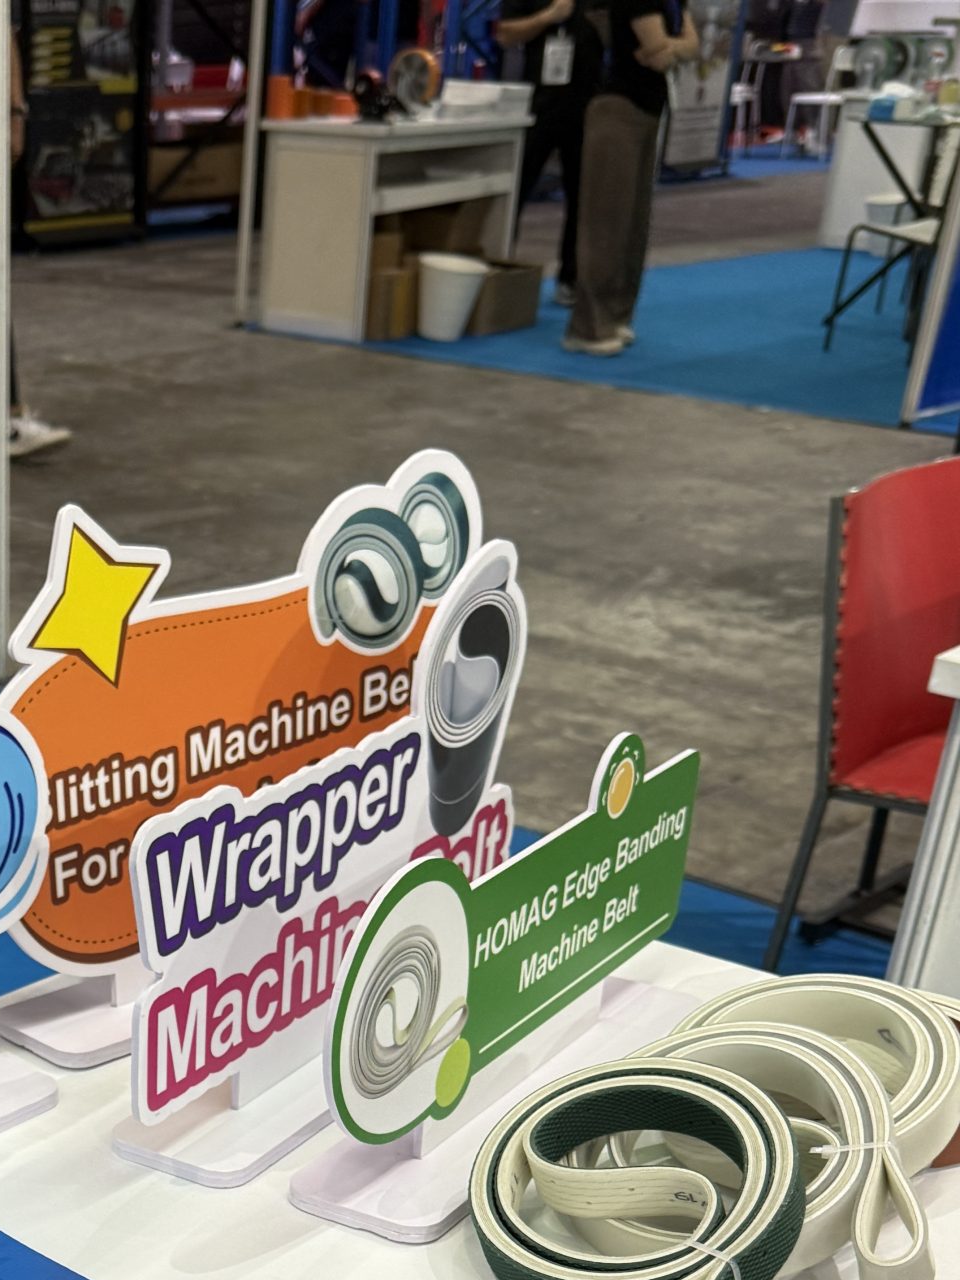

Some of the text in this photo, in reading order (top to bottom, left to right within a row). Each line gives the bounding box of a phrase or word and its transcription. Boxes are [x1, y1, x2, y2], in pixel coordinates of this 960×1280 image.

[46, 750, 175, 824] litting
[188, 692, 351, 778] Machine
[53, 843, 126, 898] For
[155, 746, 415, 941] Wrapper
[474, 806, 688, 969] HOMAG Edge Banding
[518, 884, 641, 993] Machine Belt
